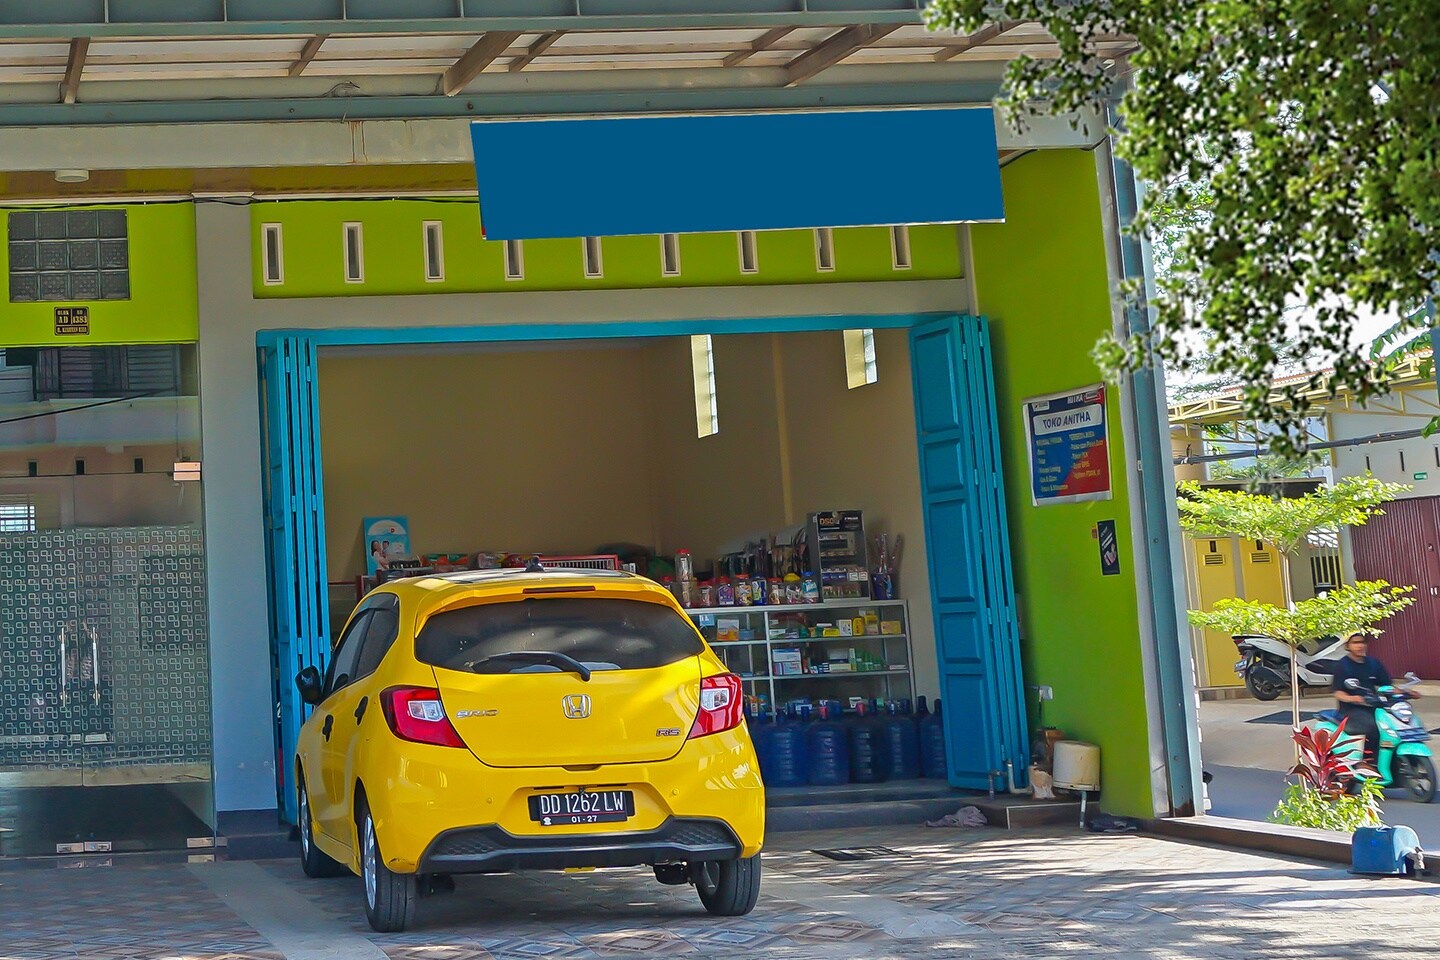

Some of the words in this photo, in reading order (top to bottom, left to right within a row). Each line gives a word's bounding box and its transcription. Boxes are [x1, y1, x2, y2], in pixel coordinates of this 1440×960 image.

[1042, 417, 1061, 429] TOKO
[1063, 411, 1091, 426] ANITHA
[656, 727, 681, 737] RS
[540, 794, 561, 814] DD
[564, 792, 600, 813] 1262
[603, 791, 623, 811] LW
